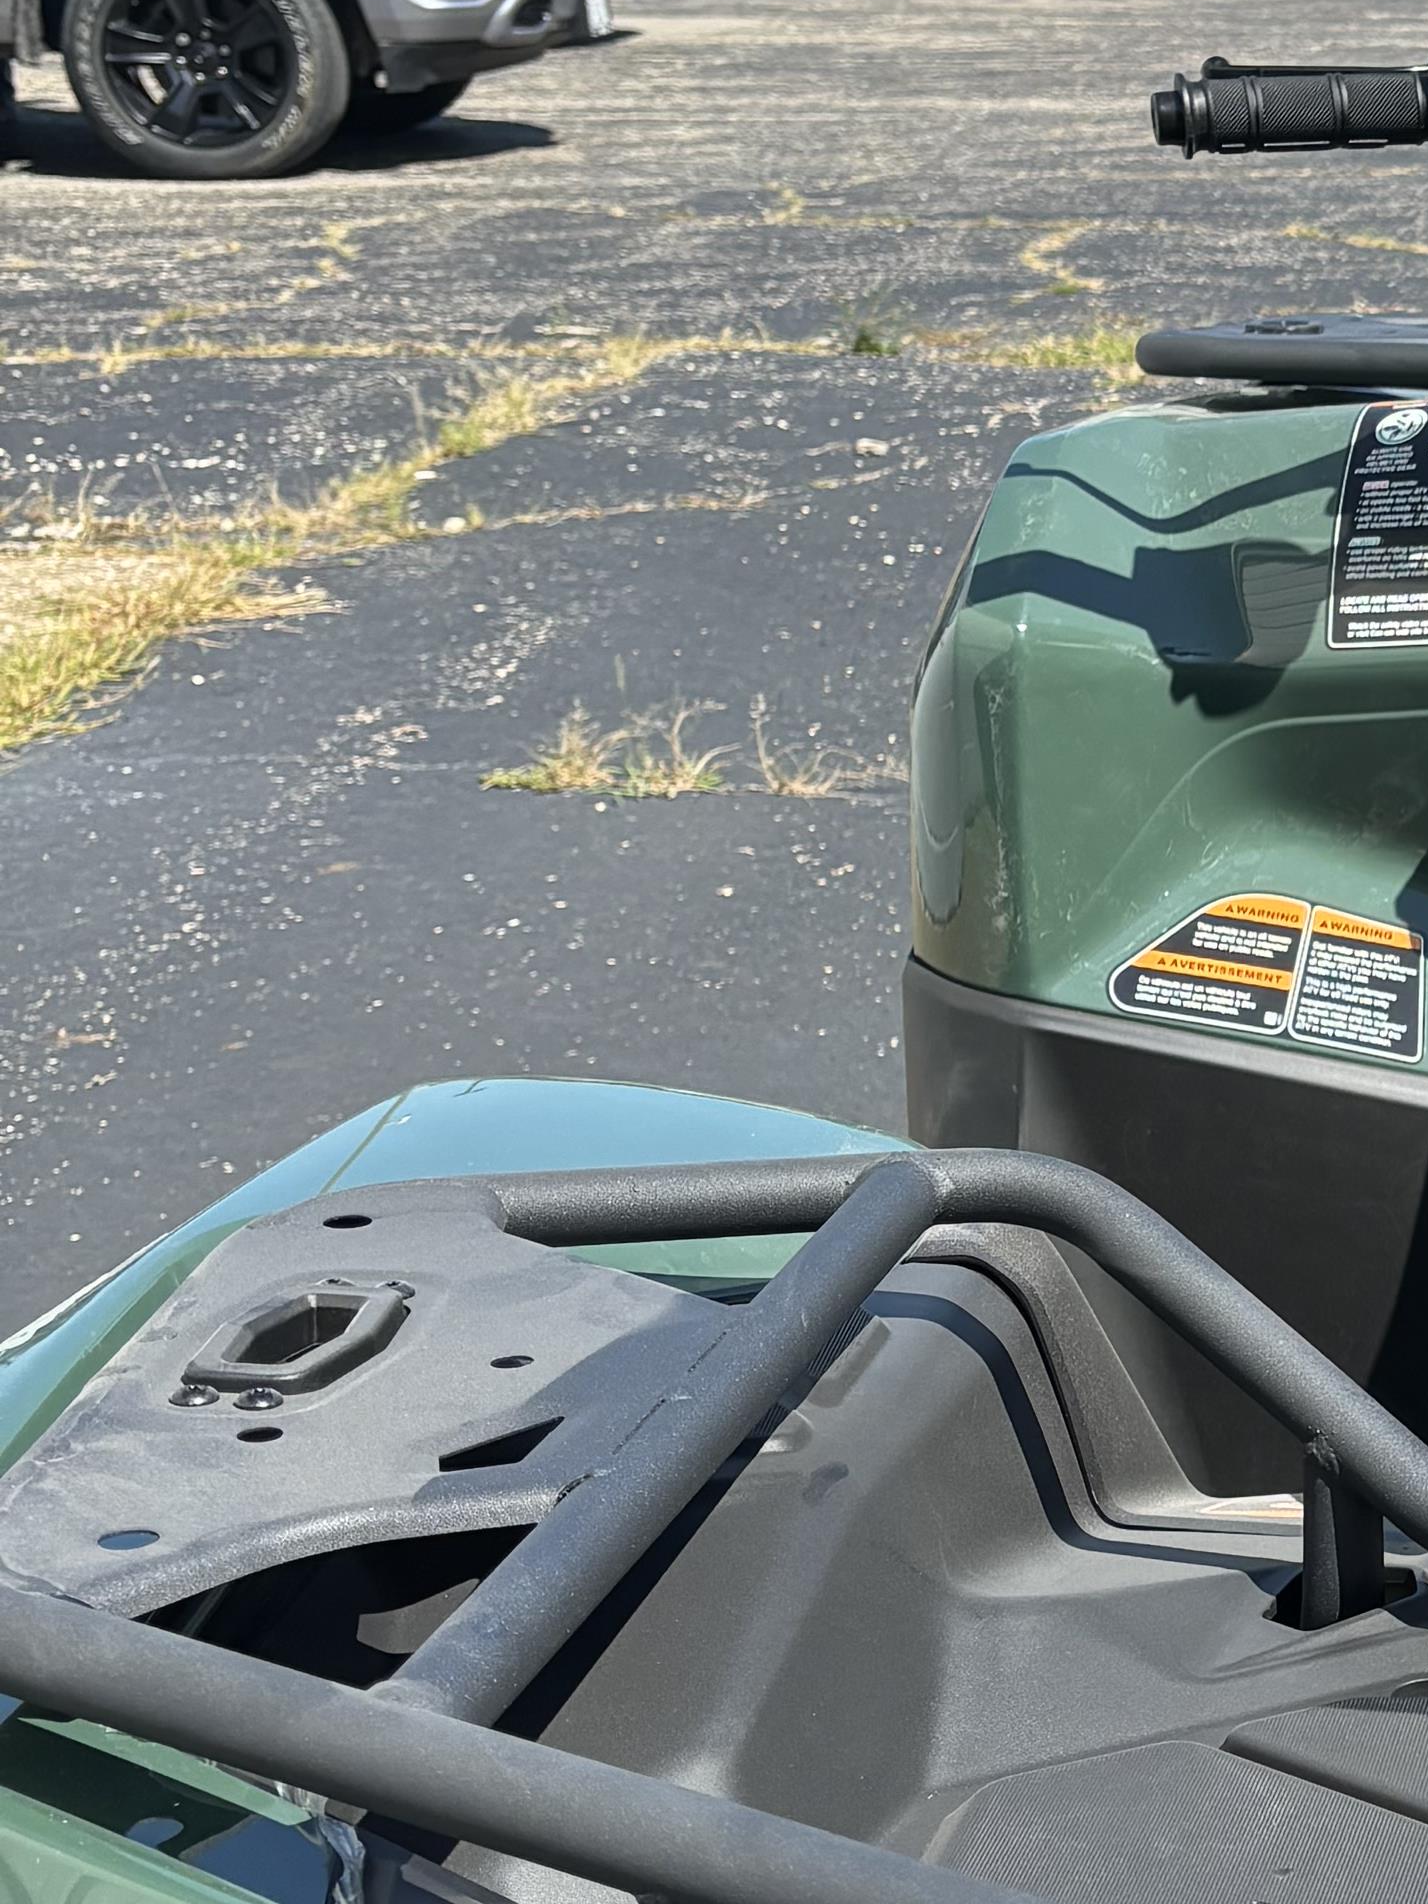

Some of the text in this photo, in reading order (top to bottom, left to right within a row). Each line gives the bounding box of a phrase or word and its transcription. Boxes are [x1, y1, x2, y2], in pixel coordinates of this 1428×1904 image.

[1237, 905, 1299, 923] WARNING
[1331, 921, 1393, 940] WARNING
[1170, 958, 1284, 984] AVERTISSEMENT
